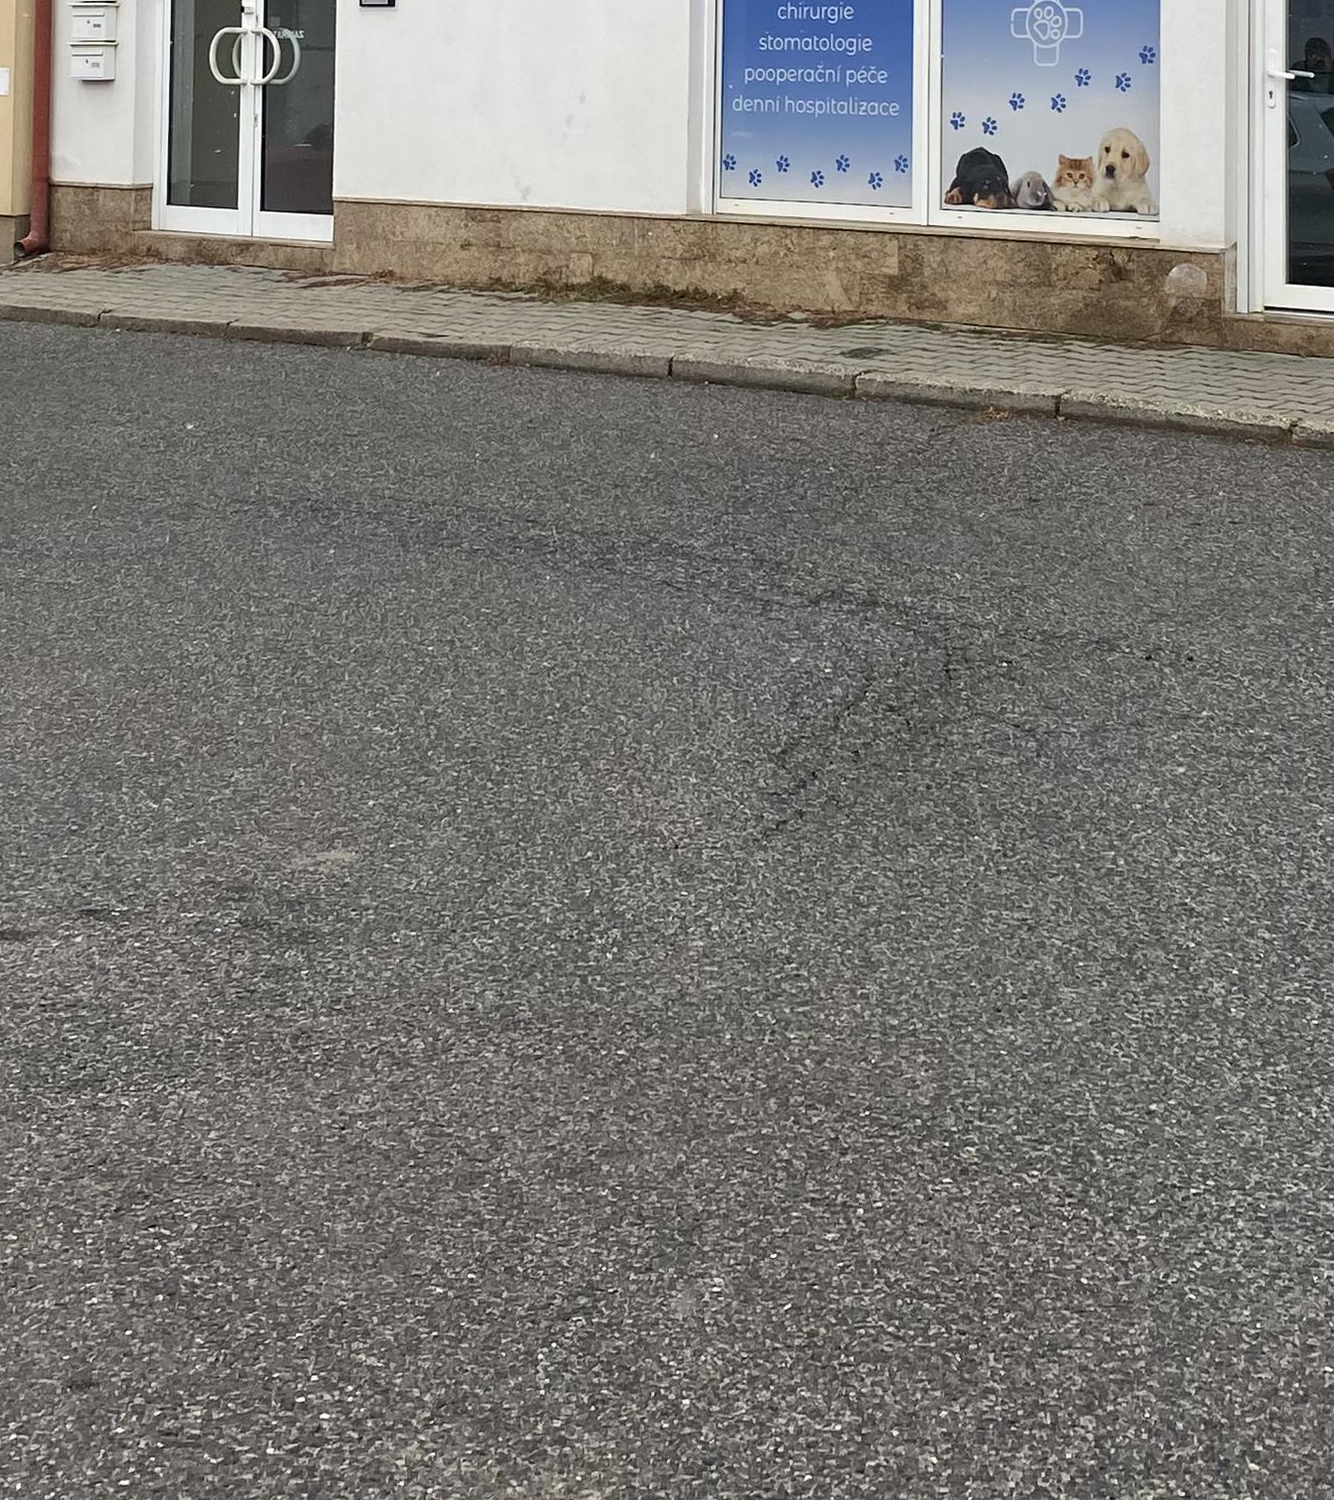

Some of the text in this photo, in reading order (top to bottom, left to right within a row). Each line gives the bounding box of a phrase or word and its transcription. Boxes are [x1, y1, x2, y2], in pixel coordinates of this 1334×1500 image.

[777, 2, 854, 24] chirurgie
[759, 34, 873, 55] stomatologie
[744, 64, 888, 87] pooperační péče
[732, 95, 900, 118] denní hospitalizace
